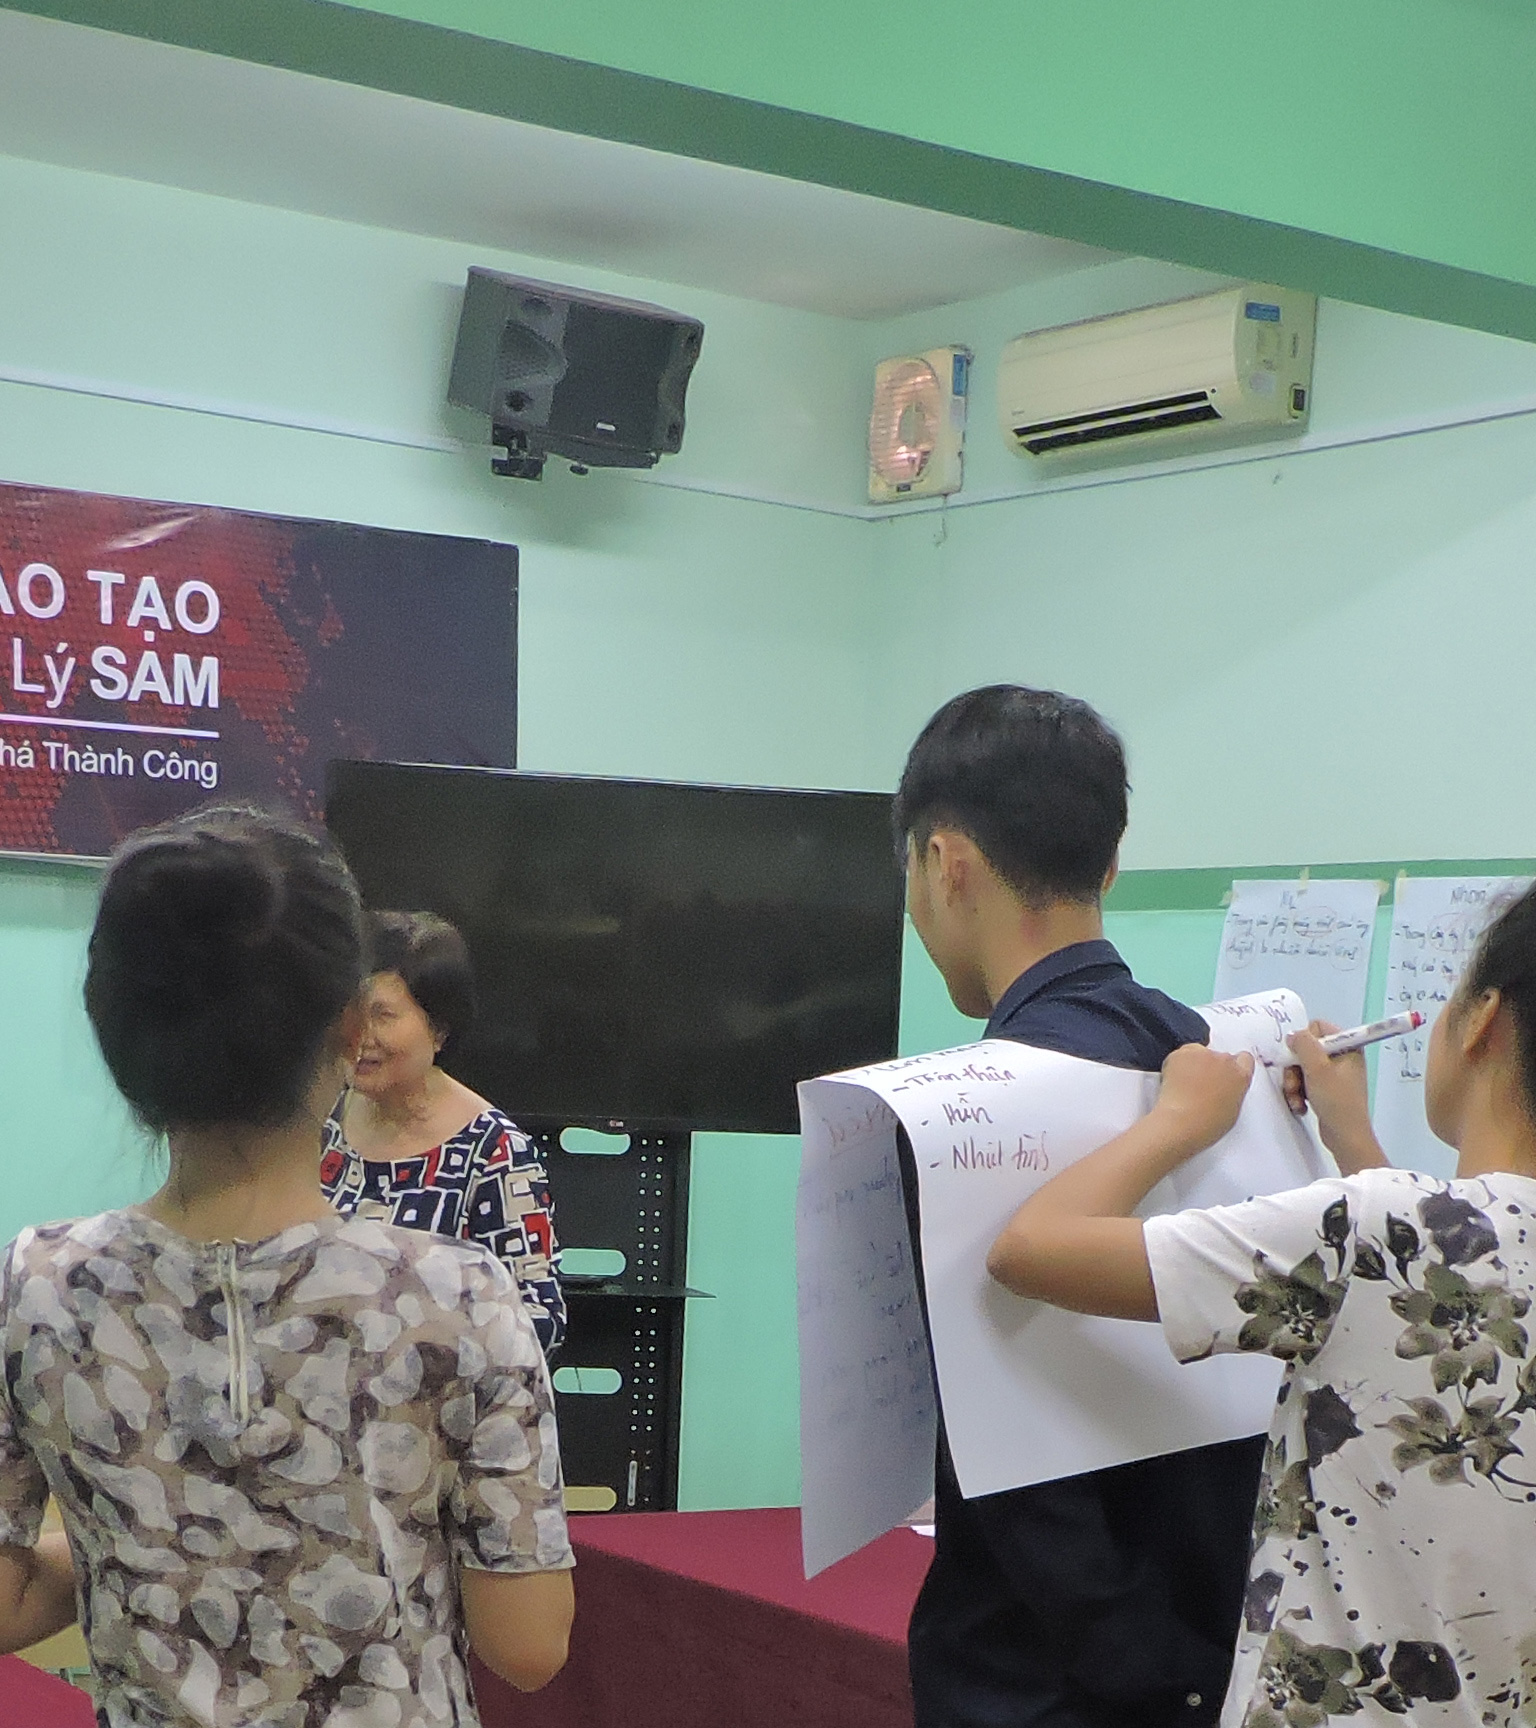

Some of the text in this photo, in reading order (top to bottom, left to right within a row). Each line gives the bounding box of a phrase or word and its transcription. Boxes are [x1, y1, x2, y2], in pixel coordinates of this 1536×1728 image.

[87, 569, 220, 643] TẠO
[13, 637, 76, 709] Lý
[89, 644, 220, 709] SAM
[41, 739, 134, 777] Thành
[142, 749, 219, 789] Công
